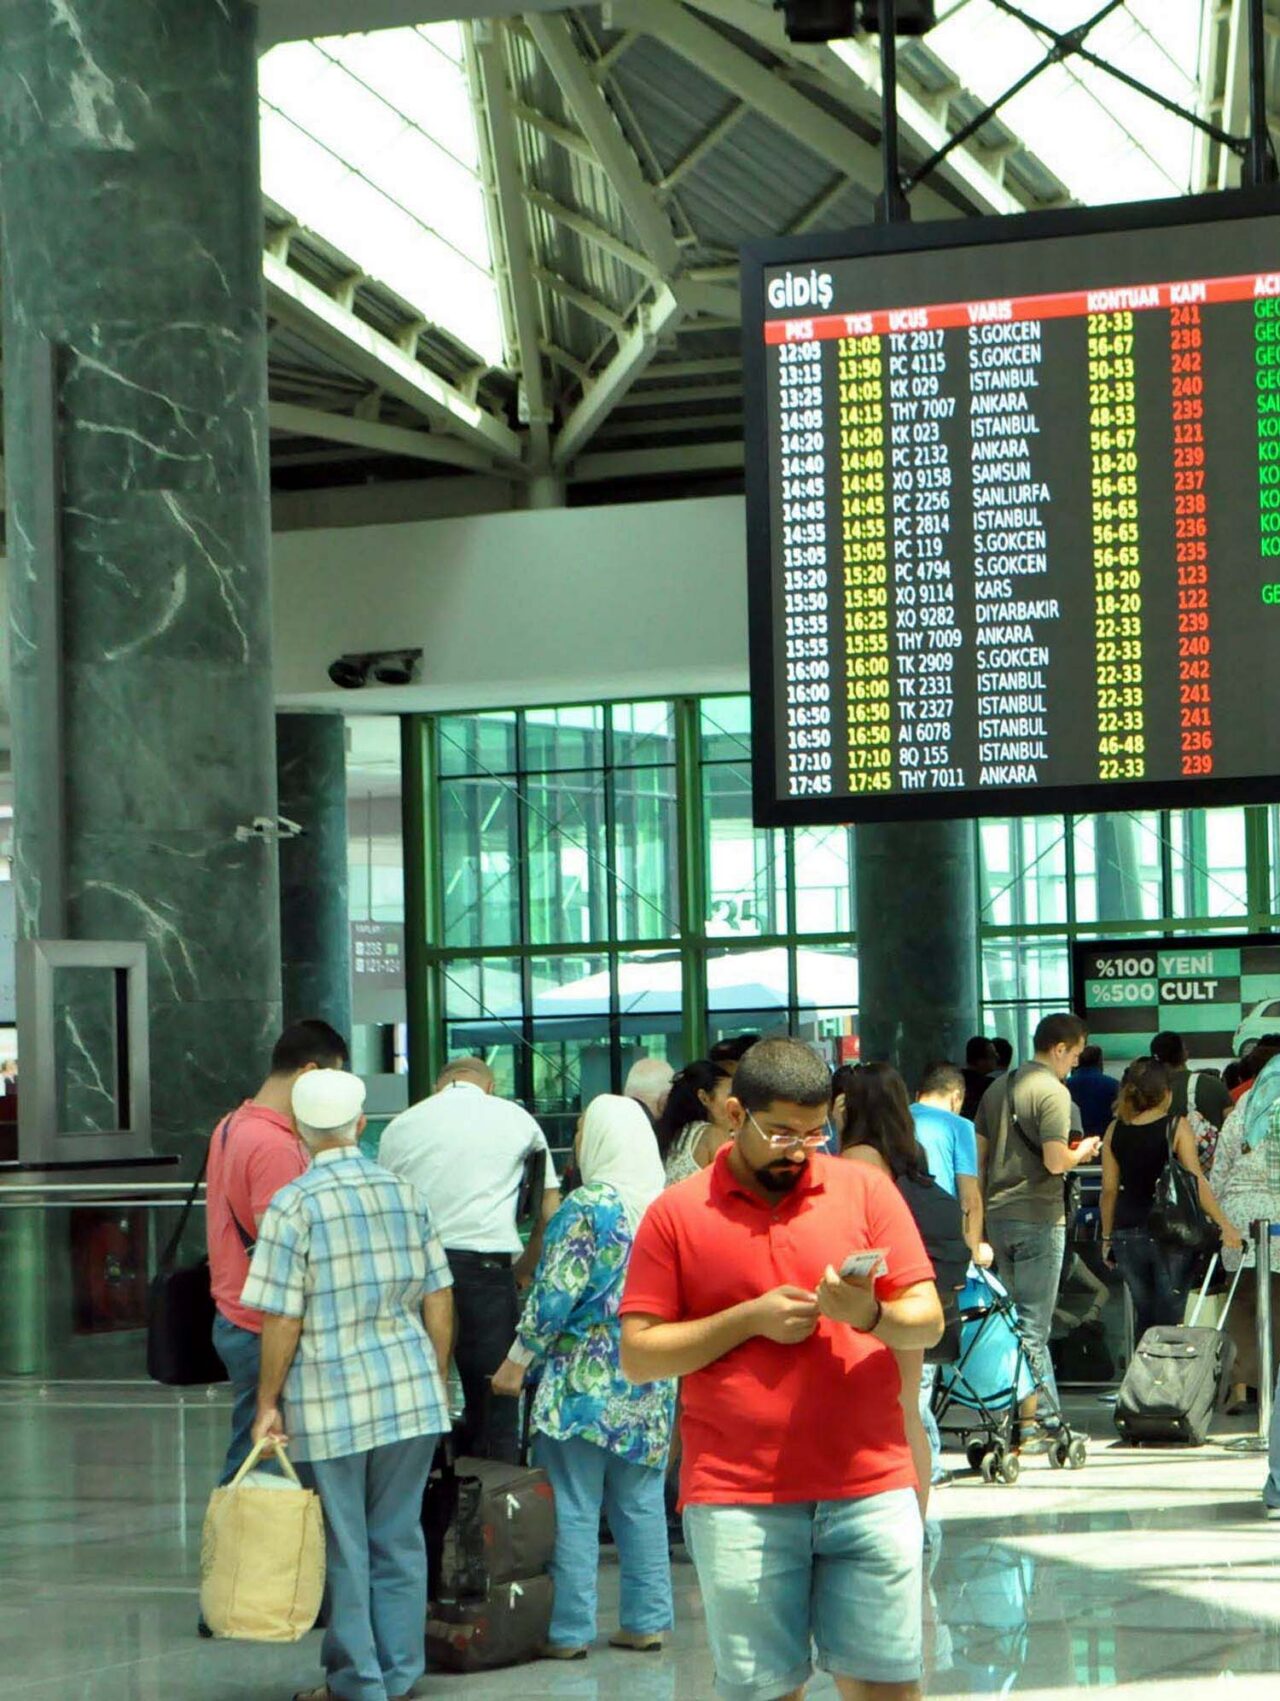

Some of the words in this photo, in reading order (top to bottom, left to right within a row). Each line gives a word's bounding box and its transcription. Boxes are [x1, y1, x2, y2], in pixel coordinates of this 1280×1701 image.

[767, 268, 834, 310] GİDİŞ
[1086, 288, 1160, 311] KONTUAR
[1170, 284, 1206, 304] KAPI
[779, 385, 822, 408] 13:25
[838, 379, 882, 403] 14:05
[890, 377, 909, 398] KK
[911, 375, 938, 396] 029
[969, 367, 1039, 391] ISTANBUL
[1088, 357, 1134, 381] 50-53
[1171, 350, 1202, 373] 242
[781, 453, 824, 477] 14:40
[840, 449, 884, 472] 14:40
[891, 446, 910, 467] PC
[913, 443, 948, 466] 2132
[970, 437, 1029, 460] ANKARA
[1090, 428, 1136, 451] 56-67
[1173, 422, 1204, 444] 121
[781, 476, 824, 500] 14:45
[841, 471, 884, 495] 14:45
[916, 466, 951, 488] 9158
[971, 461, 1030, 484] SAMSUN
[1092, 451, 1137, 474] 18-20
[1173, 445, 1204, 468] 239
[784, 591, 827, 613] 15:50
[844, 586, 887, 608] 15:50
[918, 582, 953, 603] 9114
[974, 578, 1012, 599] KARS
[1094, 569, 1140, 591] 18-20
[1177, 563, 1208, 585] 123
[785, 614, 828, 636] 15:55
[844, 610, 887, 631] 16:25
[919, 605, 954, 626] 9282
[1095, 592, 1141, 615] 18-20
[1178, 587, 1208, 610] 122
[786, 682, 830, 703] 16:00
[846, 679, 889, 700] 16:00
[896, 677, 915, 696] TK
[918, 675, 952, 695] 2331
[977, 670, 1046, 692] ISTANBUL
[1096, 663, 1142, 685] 22-33
[1179, 658, 1210, 680] 242
[788, 774, 831, 795] 17:45
[848, 771, 891, 791] 17:45
[898, 769, 927, 788] THY
[930, 767, 964, 787] 7011
[979, 764, 1037, 784] ANKARA
[1099, 757, 1144, 779] 22-33
[1181, 753, 1212, 774] 239
[1095, 957, 1155, 978] %100
[1160, 950, 1214, 976] YENİ
[1092, 982, 1155, 1003] %500
[1160, 980, 1218, 1002] CULT
